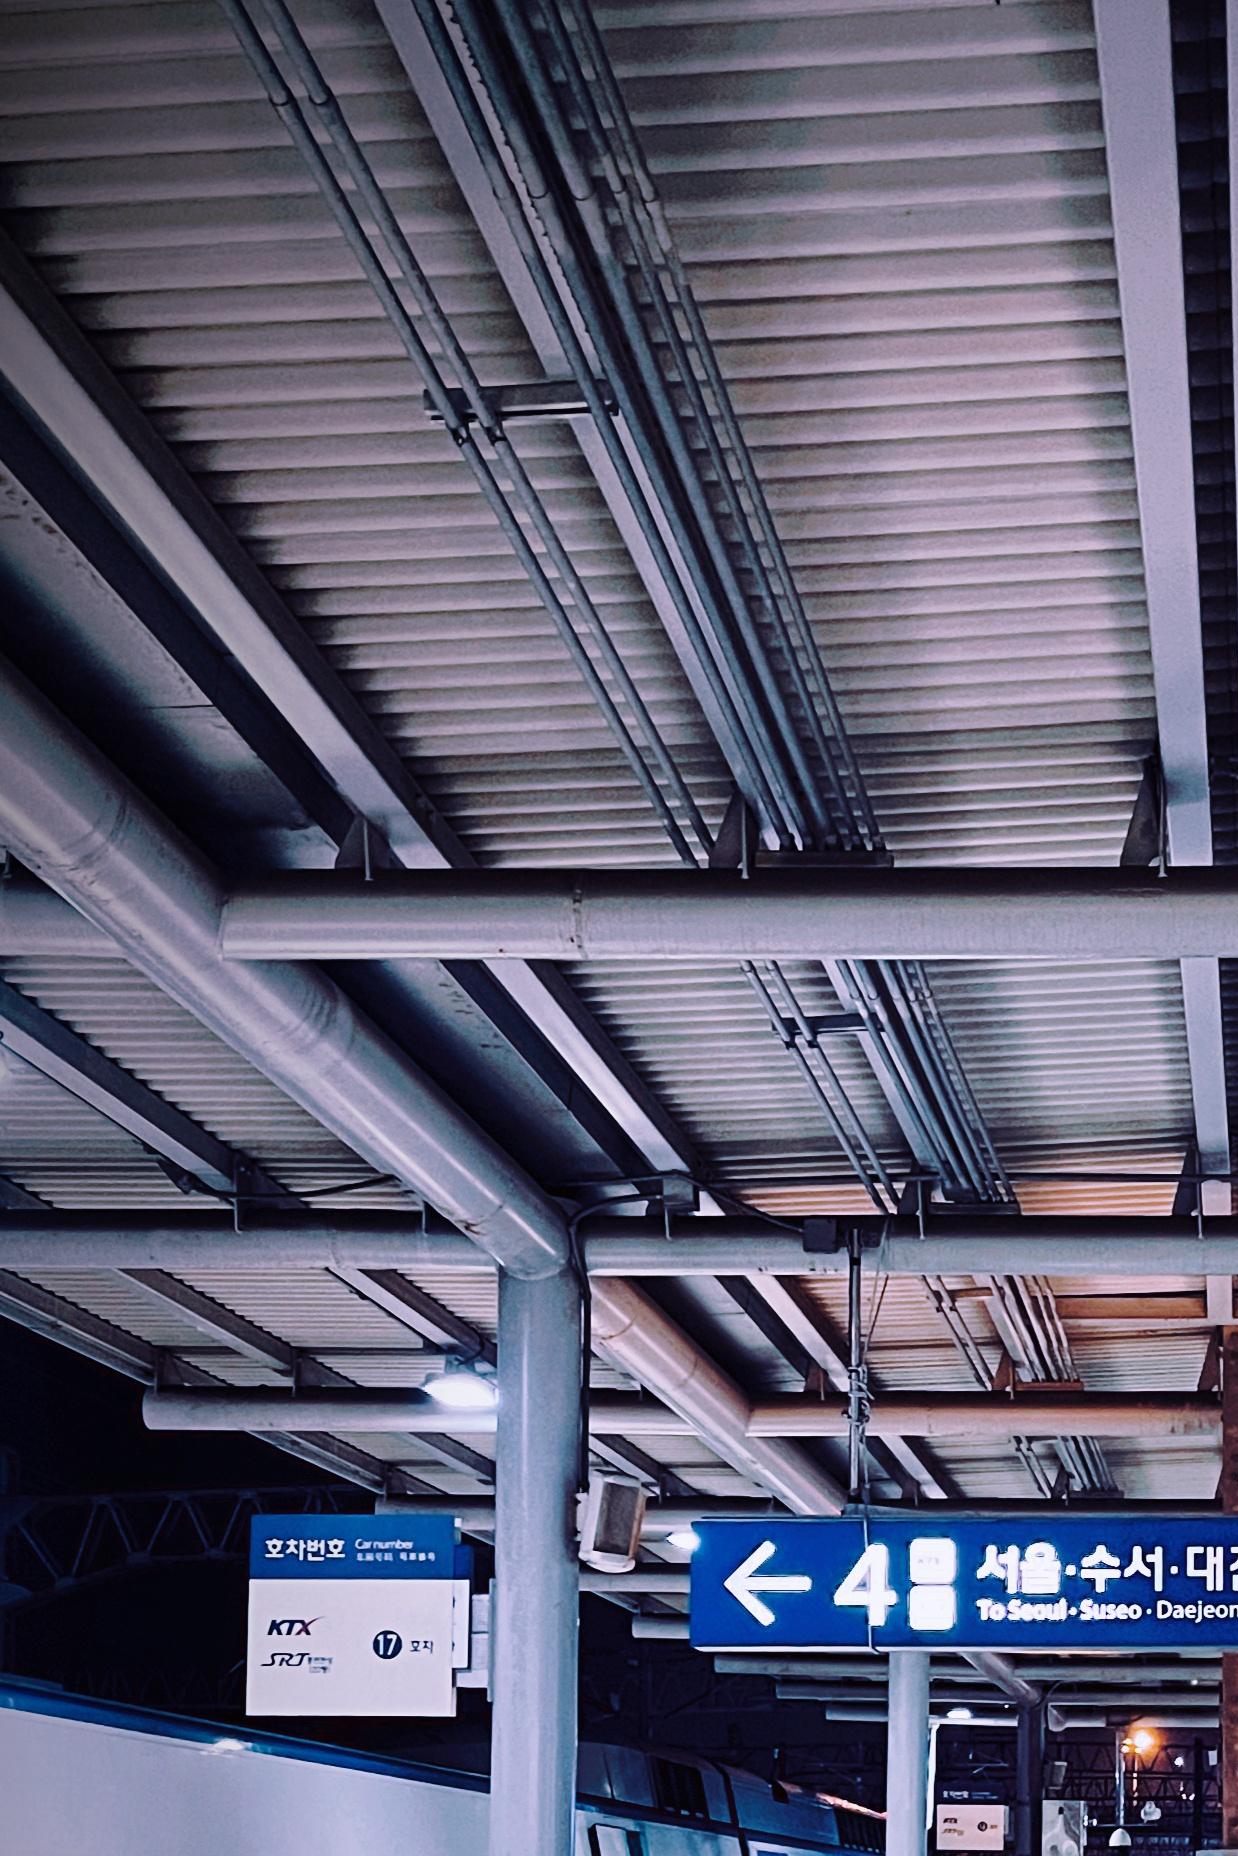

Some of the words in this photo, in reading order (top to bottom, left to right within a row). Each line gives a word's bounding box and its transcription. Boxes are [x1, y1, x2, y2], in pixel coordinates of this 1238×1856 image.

[265, 1539, 346, 1561] 호차번호
[833, 1543, 898, 1626] 4
[267, 1616, 325, 1635] KTX
[376, 1633, 397, 1656] 17
[260, 1653, 310, 1667] SRT
